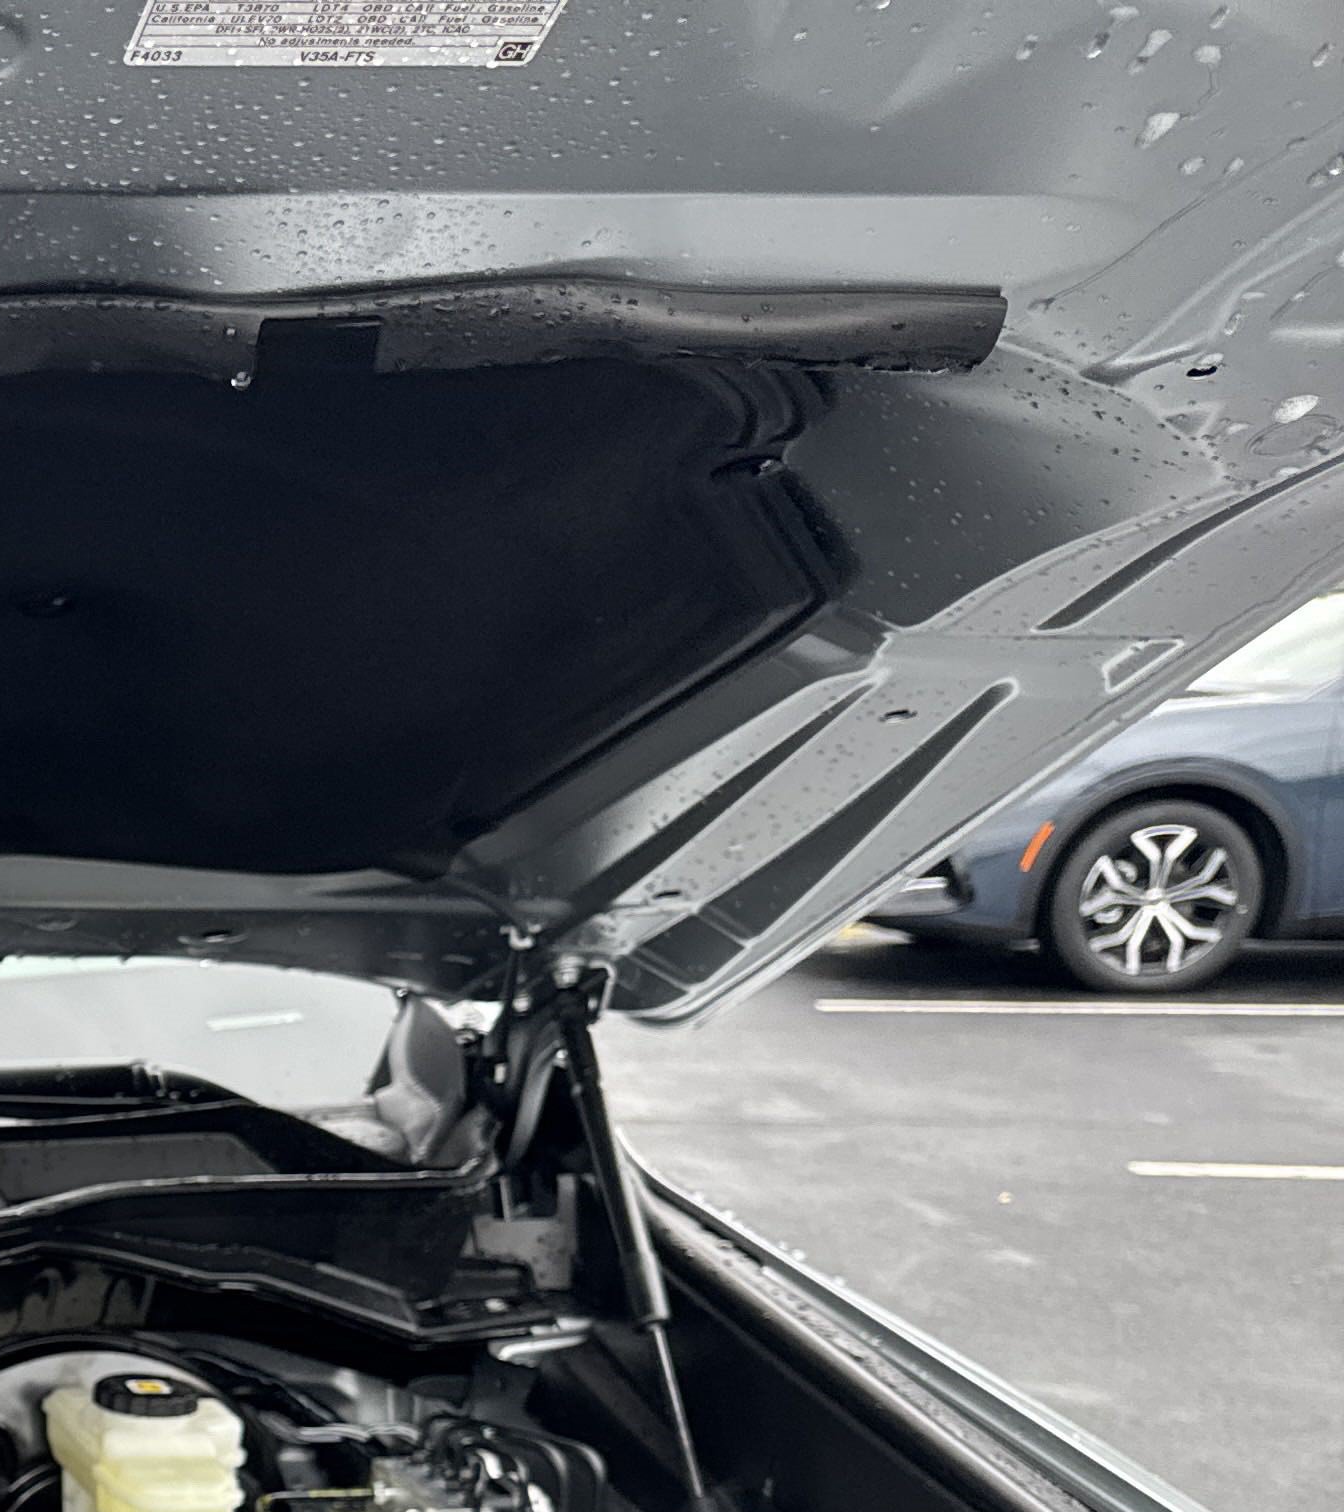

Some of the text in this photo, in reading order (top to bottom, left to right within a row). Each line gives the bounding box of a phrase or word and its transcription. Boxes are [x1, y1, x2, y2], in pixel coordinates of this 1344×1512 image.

[313, 4, 349, 12] LDT4
[362, 4, 393, 12] OBD
[445, 4, 474, 12] Fuel
[488, 4, 545, 12] Gasoline
[151, 15, 215, 23] California
[357, 15, 387, 23] OBD
[438, 15, 468, 23] Fuel
[481, 15, 539, 23] Gasoline
[258, 37, 415, 46] No adjustments needed.
[130, 43, 528, 62] F4033 V35A-FTS GH
